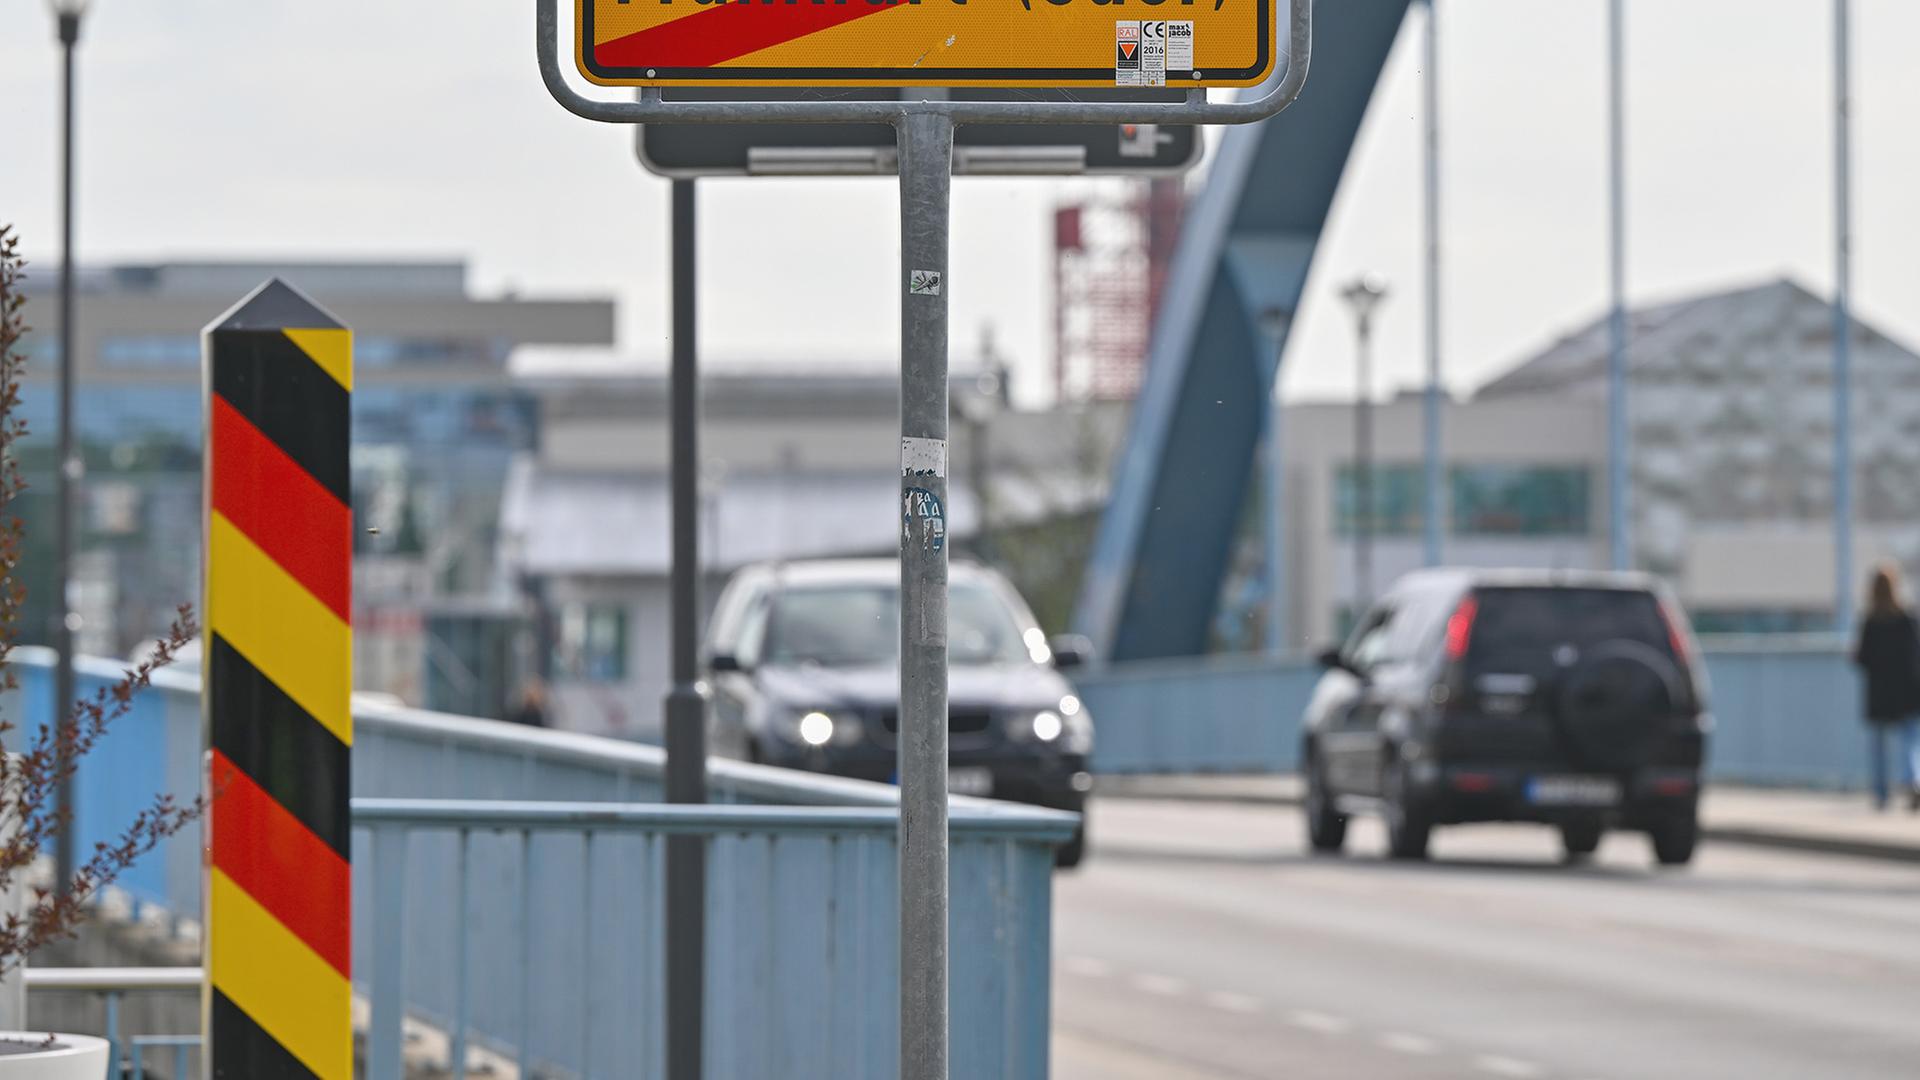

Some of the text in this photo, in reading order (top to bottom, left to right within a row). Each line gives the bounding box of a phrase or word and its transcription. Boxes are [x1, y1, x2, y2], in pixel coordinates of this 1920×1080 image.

[1119, 29, 1136, 37] RAL
[1143, 22, 1164, 38] CE
[1168, 29, 1191, 37] jacob
[1143, 46, 1164, 54] 2016
